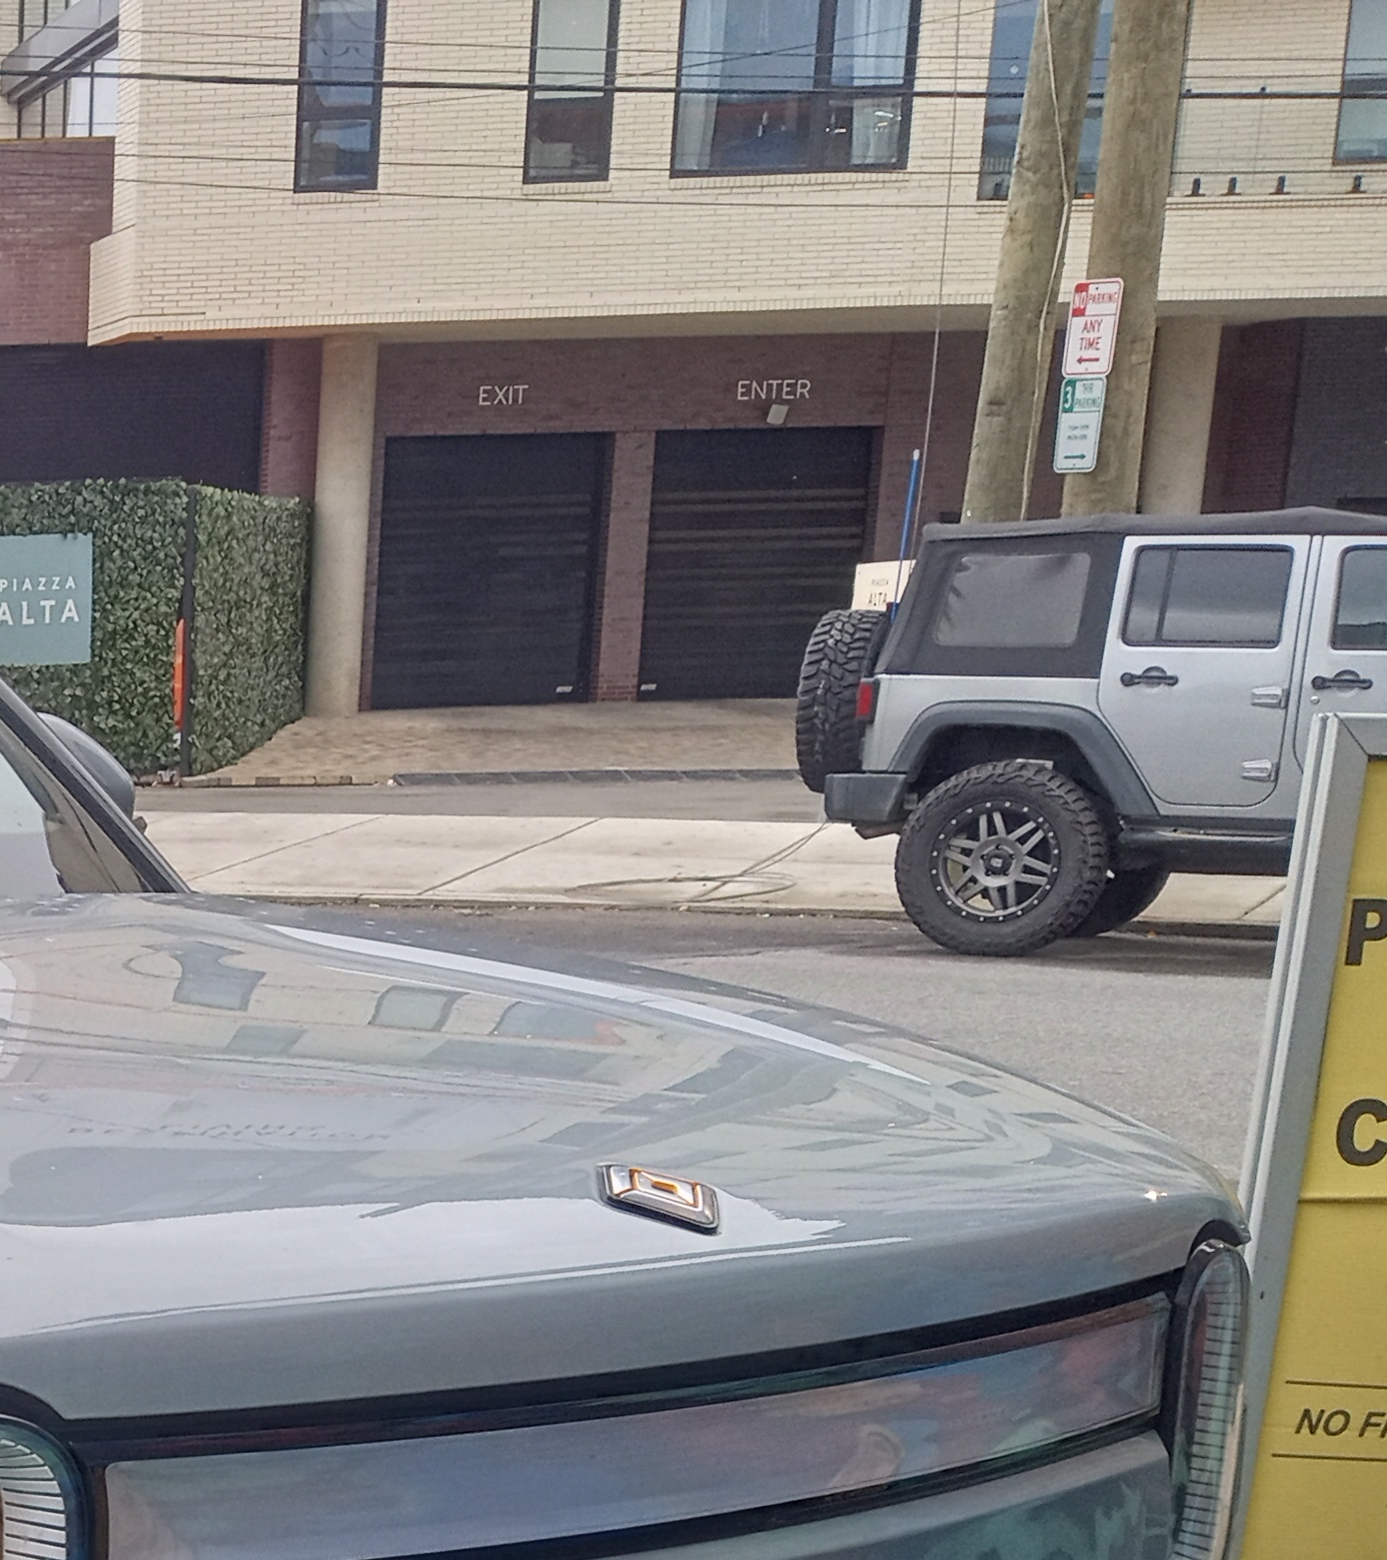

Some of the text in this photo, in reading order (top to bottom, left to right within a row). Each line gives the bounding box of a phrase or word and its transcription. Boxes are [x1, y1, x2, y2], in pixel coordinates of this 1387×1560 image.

[1073, 291, 1119, 309] NO PARKING
[1082, 319, 1103, 333] ANY
[1079, 336, 1102, 351] TIME
[478, 384, 529, 406] EXIT
[737, 379, 812, 400] ENTER
[1063, 385, 1073, 409] 3
[1294, 1407, 1351, 1437] NO
